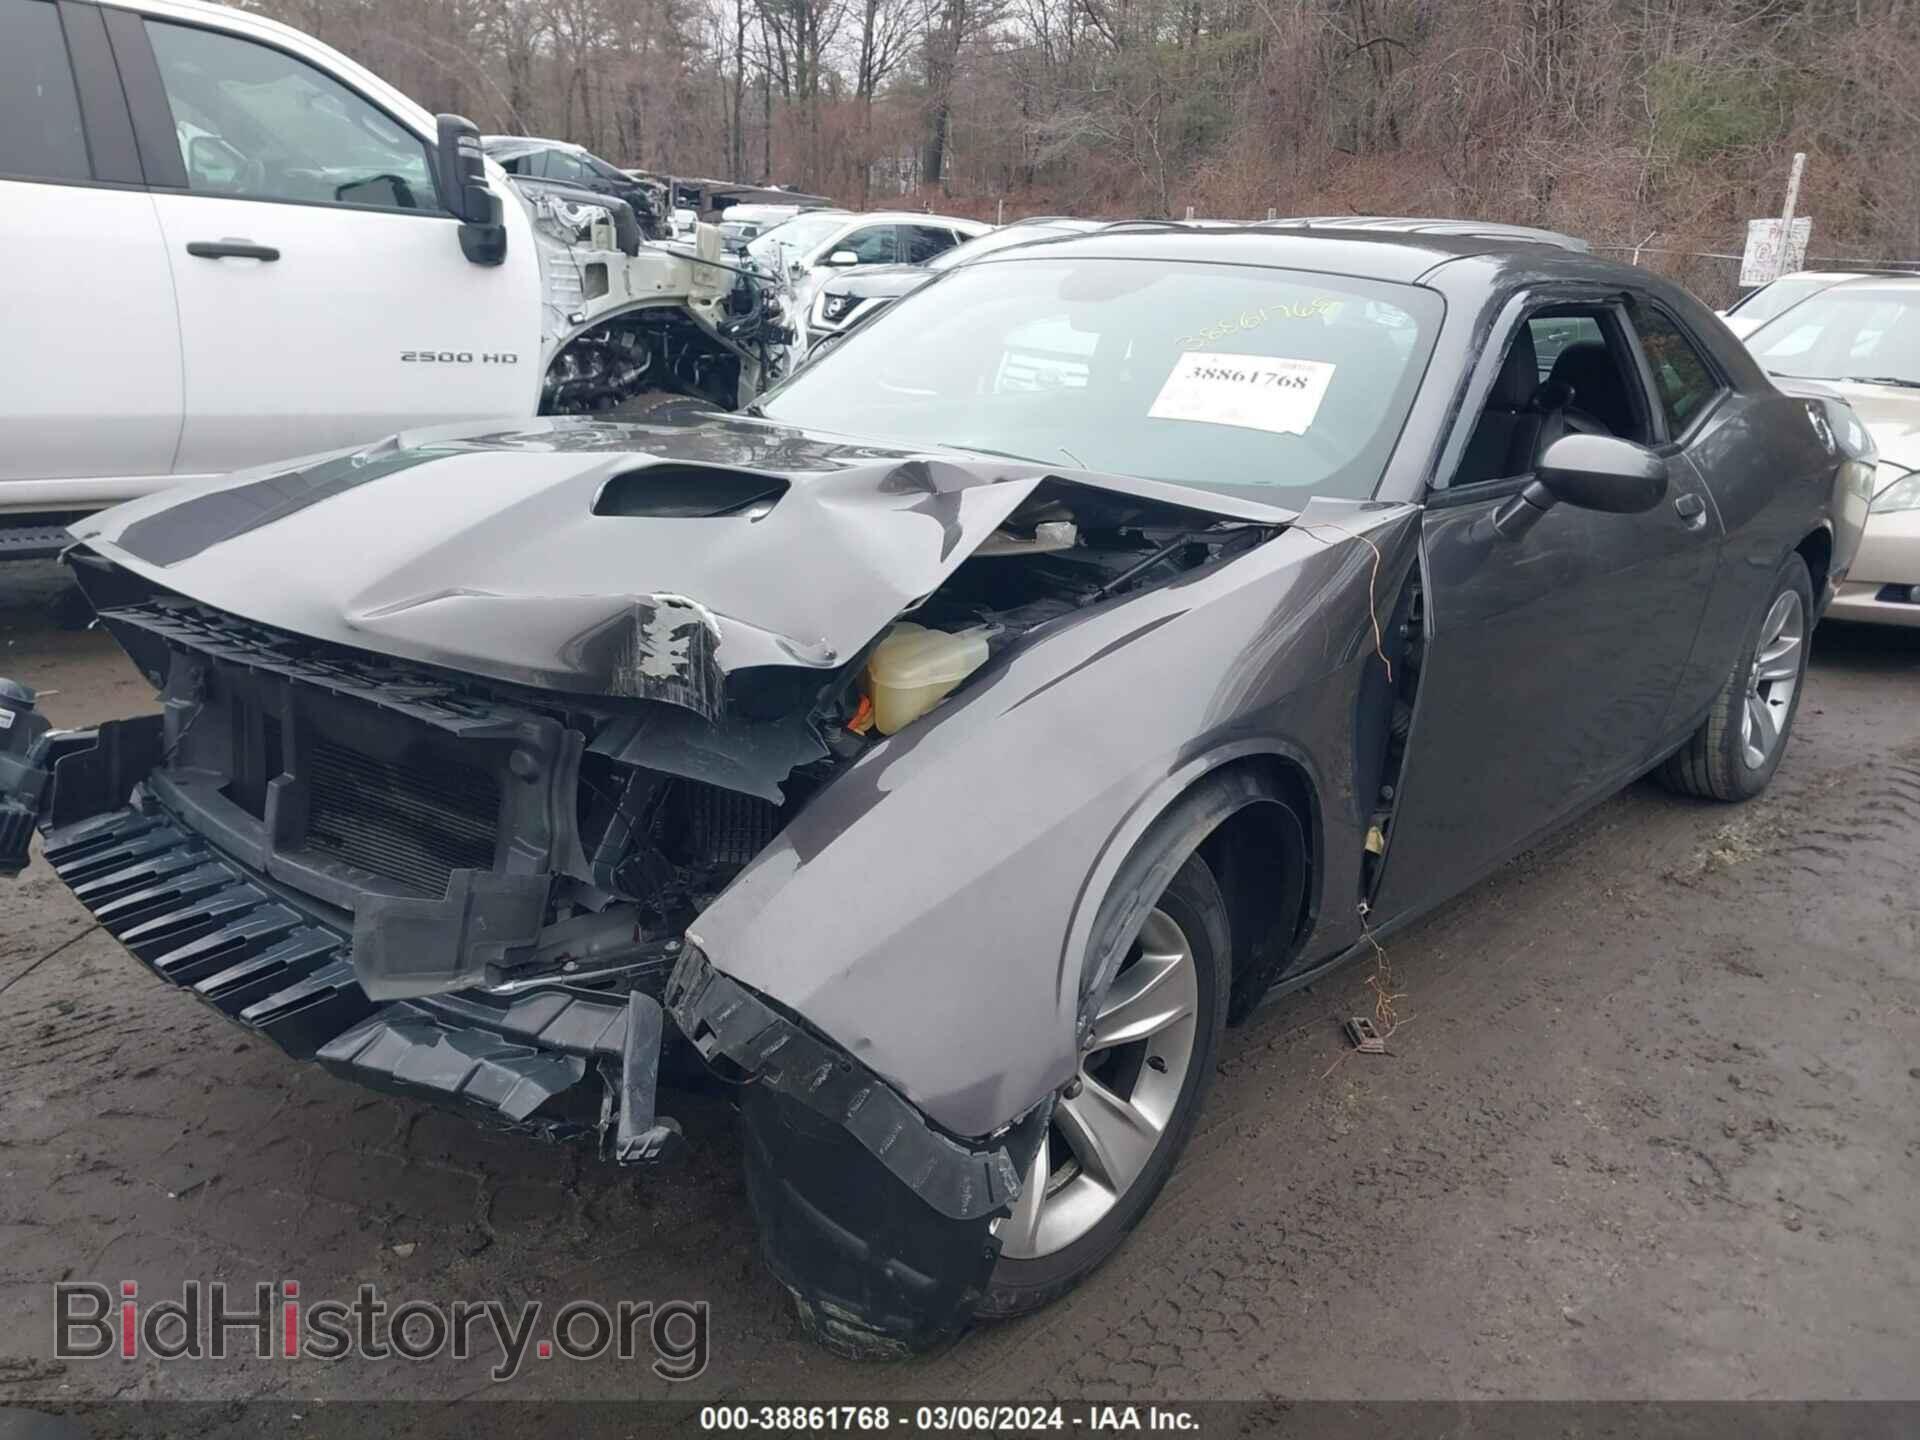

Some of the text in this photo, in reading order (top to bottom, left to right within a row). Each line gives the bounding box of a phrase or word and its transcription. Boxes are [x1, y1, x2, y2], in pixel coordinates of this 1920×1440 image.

[400, 350, 518, 364] 2500 HD
[1186, 366, 1309, 390] 38861768
